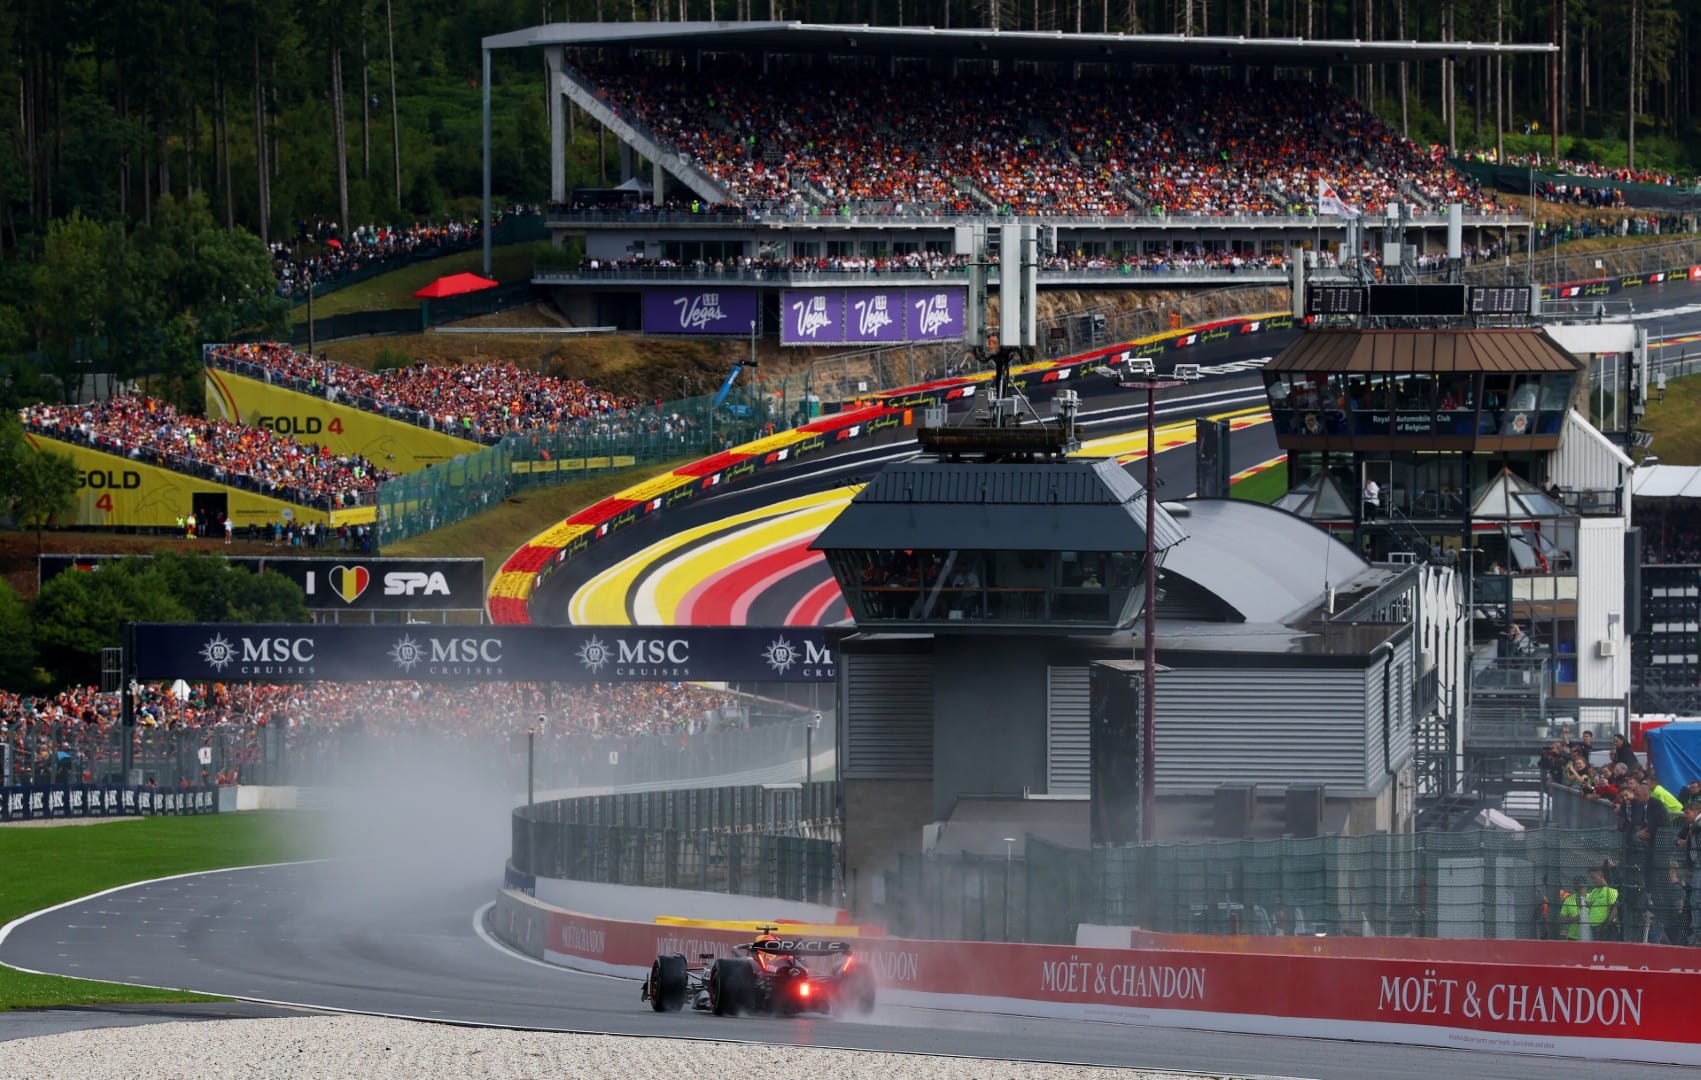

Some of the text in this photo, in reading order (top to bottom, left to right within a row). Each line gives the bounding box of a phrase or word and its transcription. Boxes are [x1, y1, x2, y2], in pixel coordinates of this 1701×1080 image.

[1312, 288, 1363, 312] 27.07
[1472, 288, 1530, 311] 27.07
[673, 295, 728, 330] Vegas
[793, 299, 832, 338] Vegas
[854, 298, 893, 337] Vegas
[915, 297, 953, 336] Vegas
[258, 416, 344, 434] GOLD 4
[95, 493, 113, 512] 4
[306, 571, 451, 595] I SPA
[241, 638, 315, 662] MSC
[429, 638, 503, 662] MSC
[616, 639, 689, 663] MSC
[241, 666, 315, 674] CRUISES
[616, 668, 690, 676] CRUISES
[764, 940, 841, 951] ORACLE
[1041, 954, 1207, 1001] MOËT & CHANDON
[1377, 968, 1644, 1026] MOËT & CHANDON
